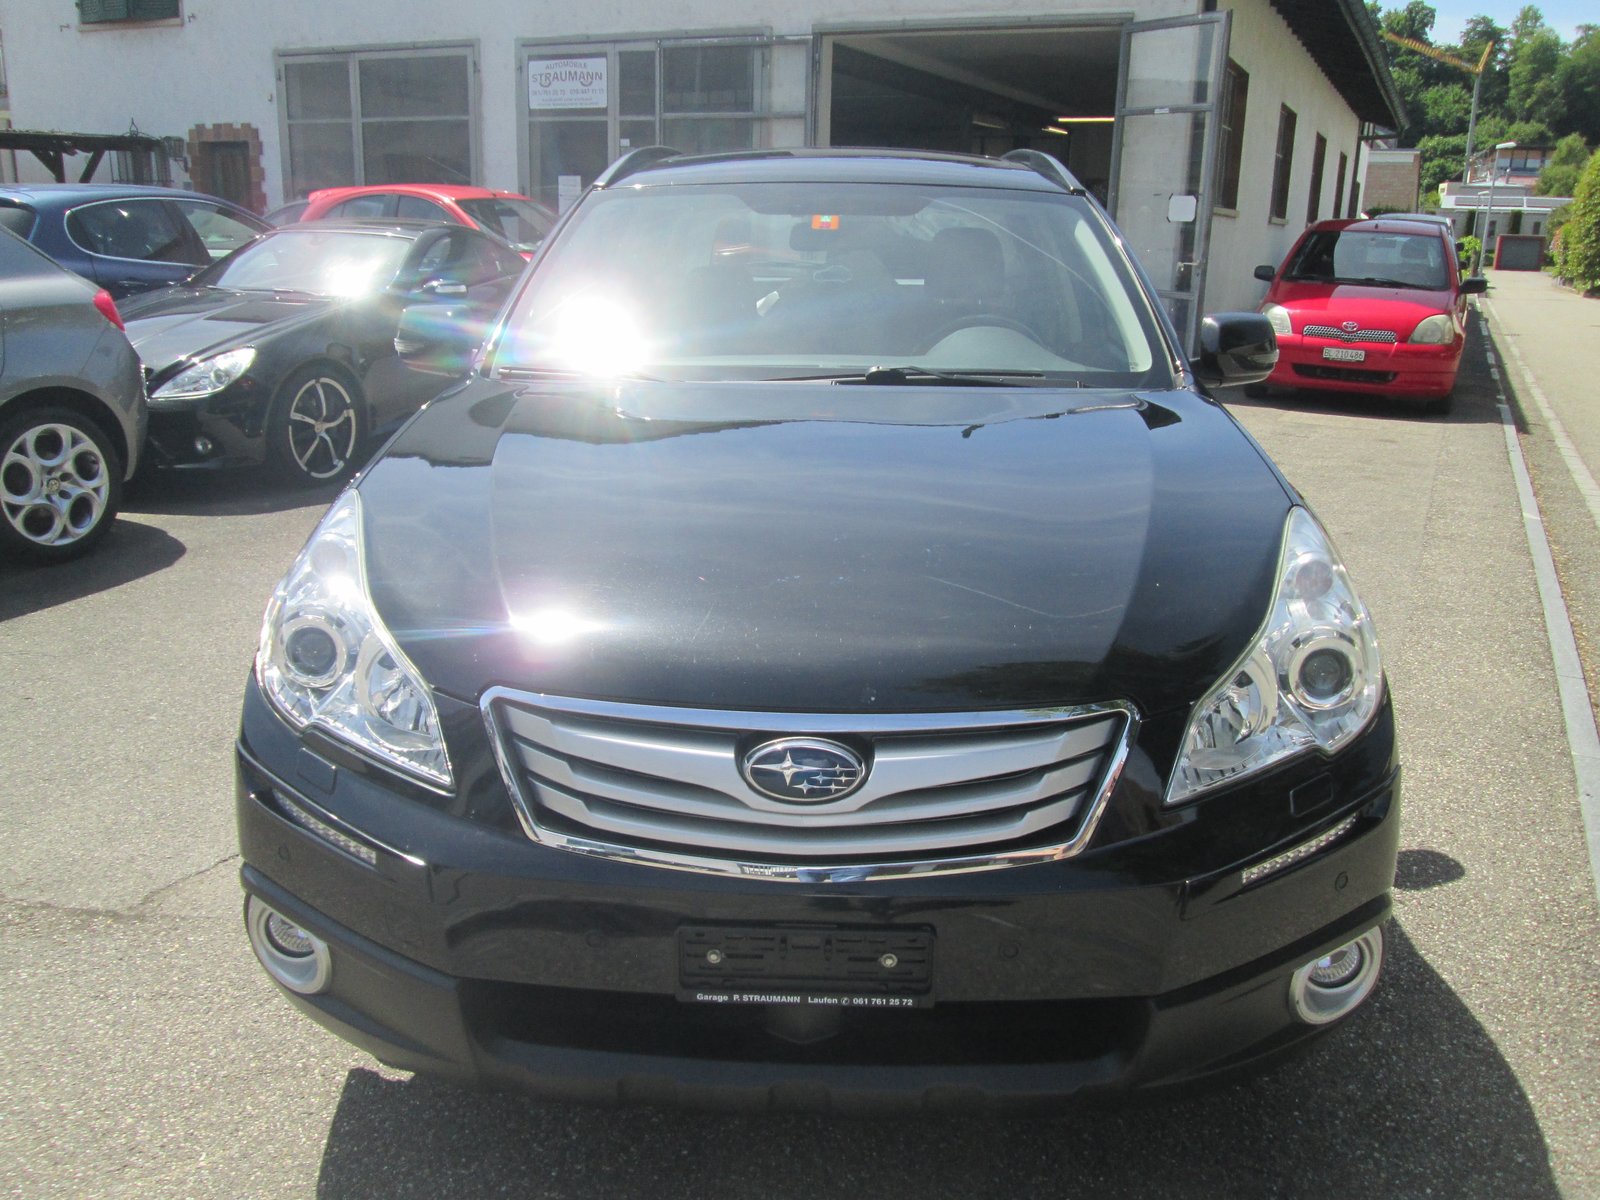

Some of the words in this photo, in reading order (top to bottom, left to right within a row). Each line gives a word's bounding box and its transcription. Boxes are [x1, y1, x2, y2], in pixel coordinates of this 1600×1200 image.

[531, 70, 603, 83] STRAUMANN
[696, 993, 728, 1002] Garage
[742, 994, 800, 1003] STRAUMANN
[807, 996, 838, 1004] Laufen
[852, 997, 868, 1005] 061
[888, 998, 900, 1006] 25
[902, 998, 913, 1006] 72
